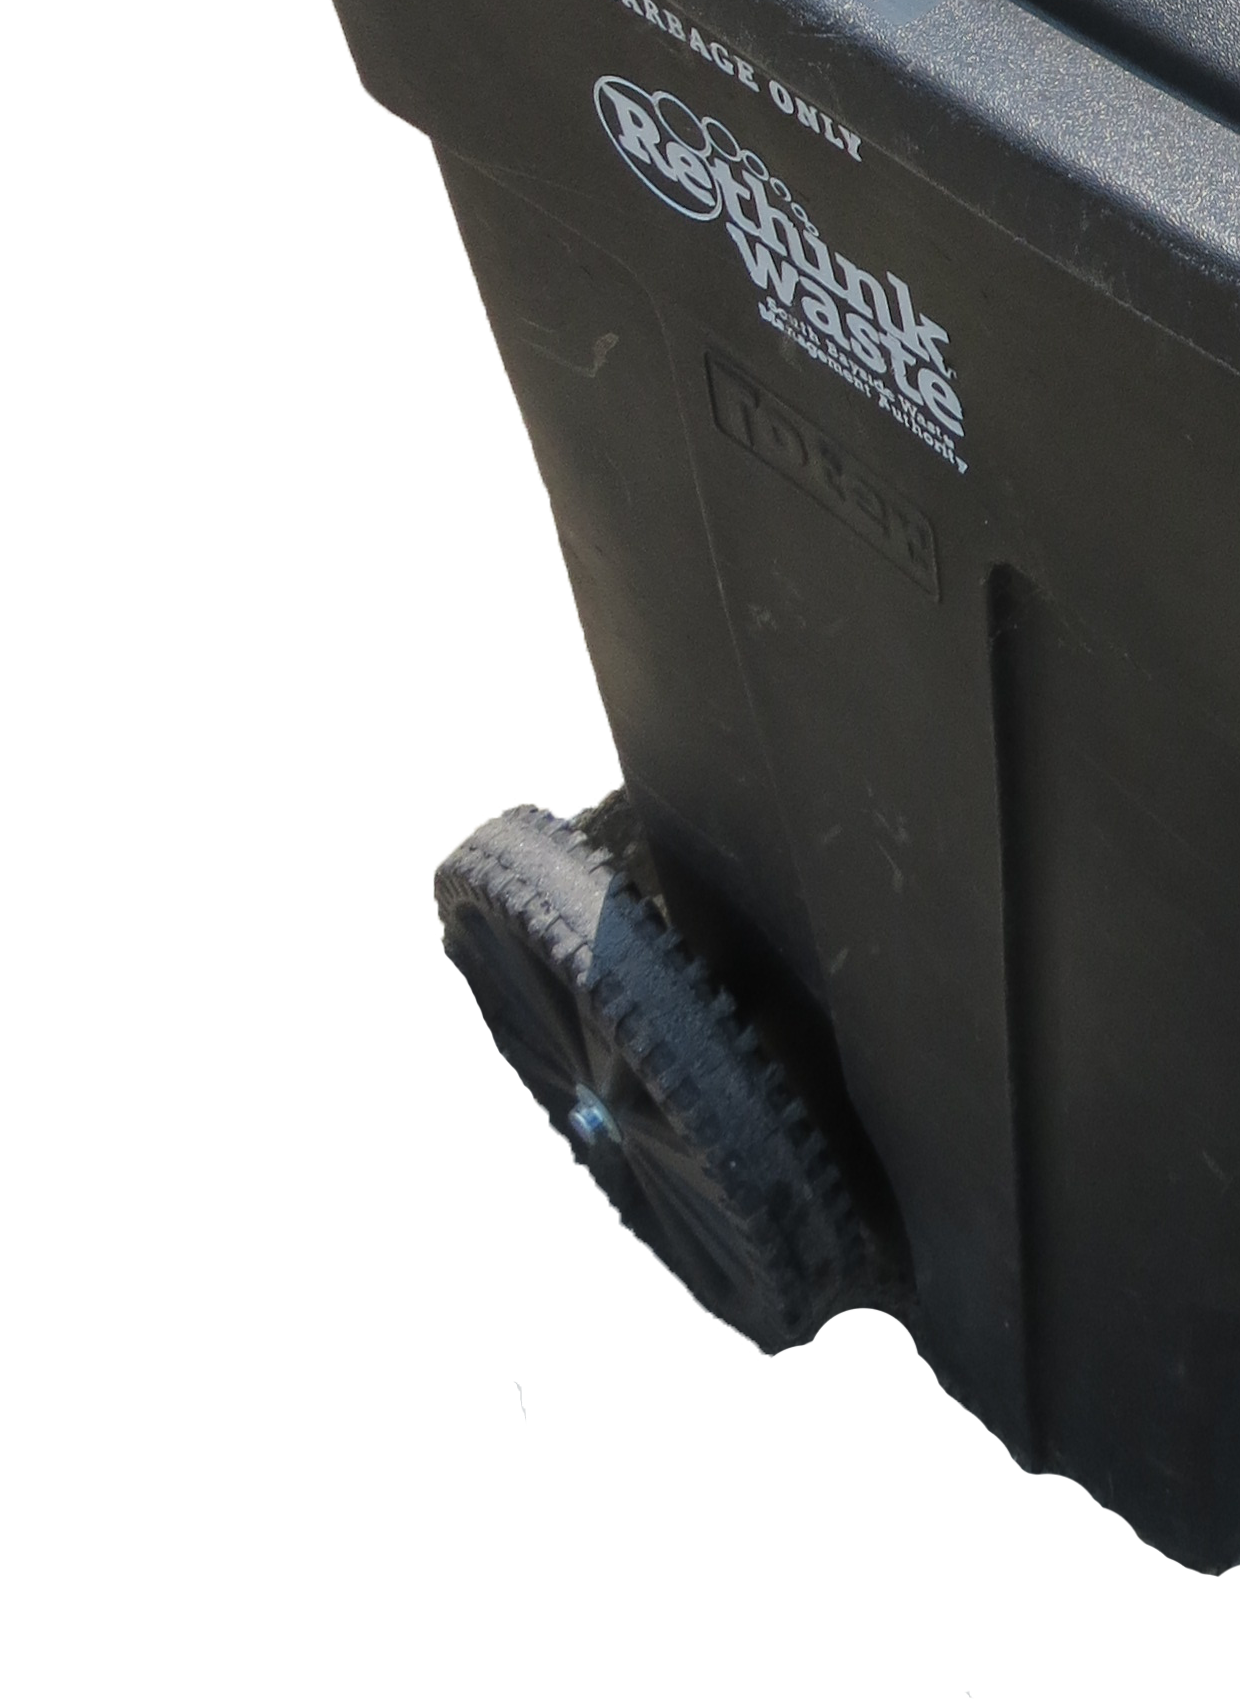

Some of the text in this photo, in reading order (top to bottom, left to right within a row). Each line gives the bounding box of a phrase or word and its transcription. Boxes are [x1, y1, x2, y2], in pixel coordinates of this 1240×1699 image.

[768, 79, 862, 162] ONLY
[600, 82, 952, 378] Rethink
[726, 221, 965, 437] waste
[758, 301, 969, 475] Management Authority
[766, 296, 956, 451] South Bayside Waste
